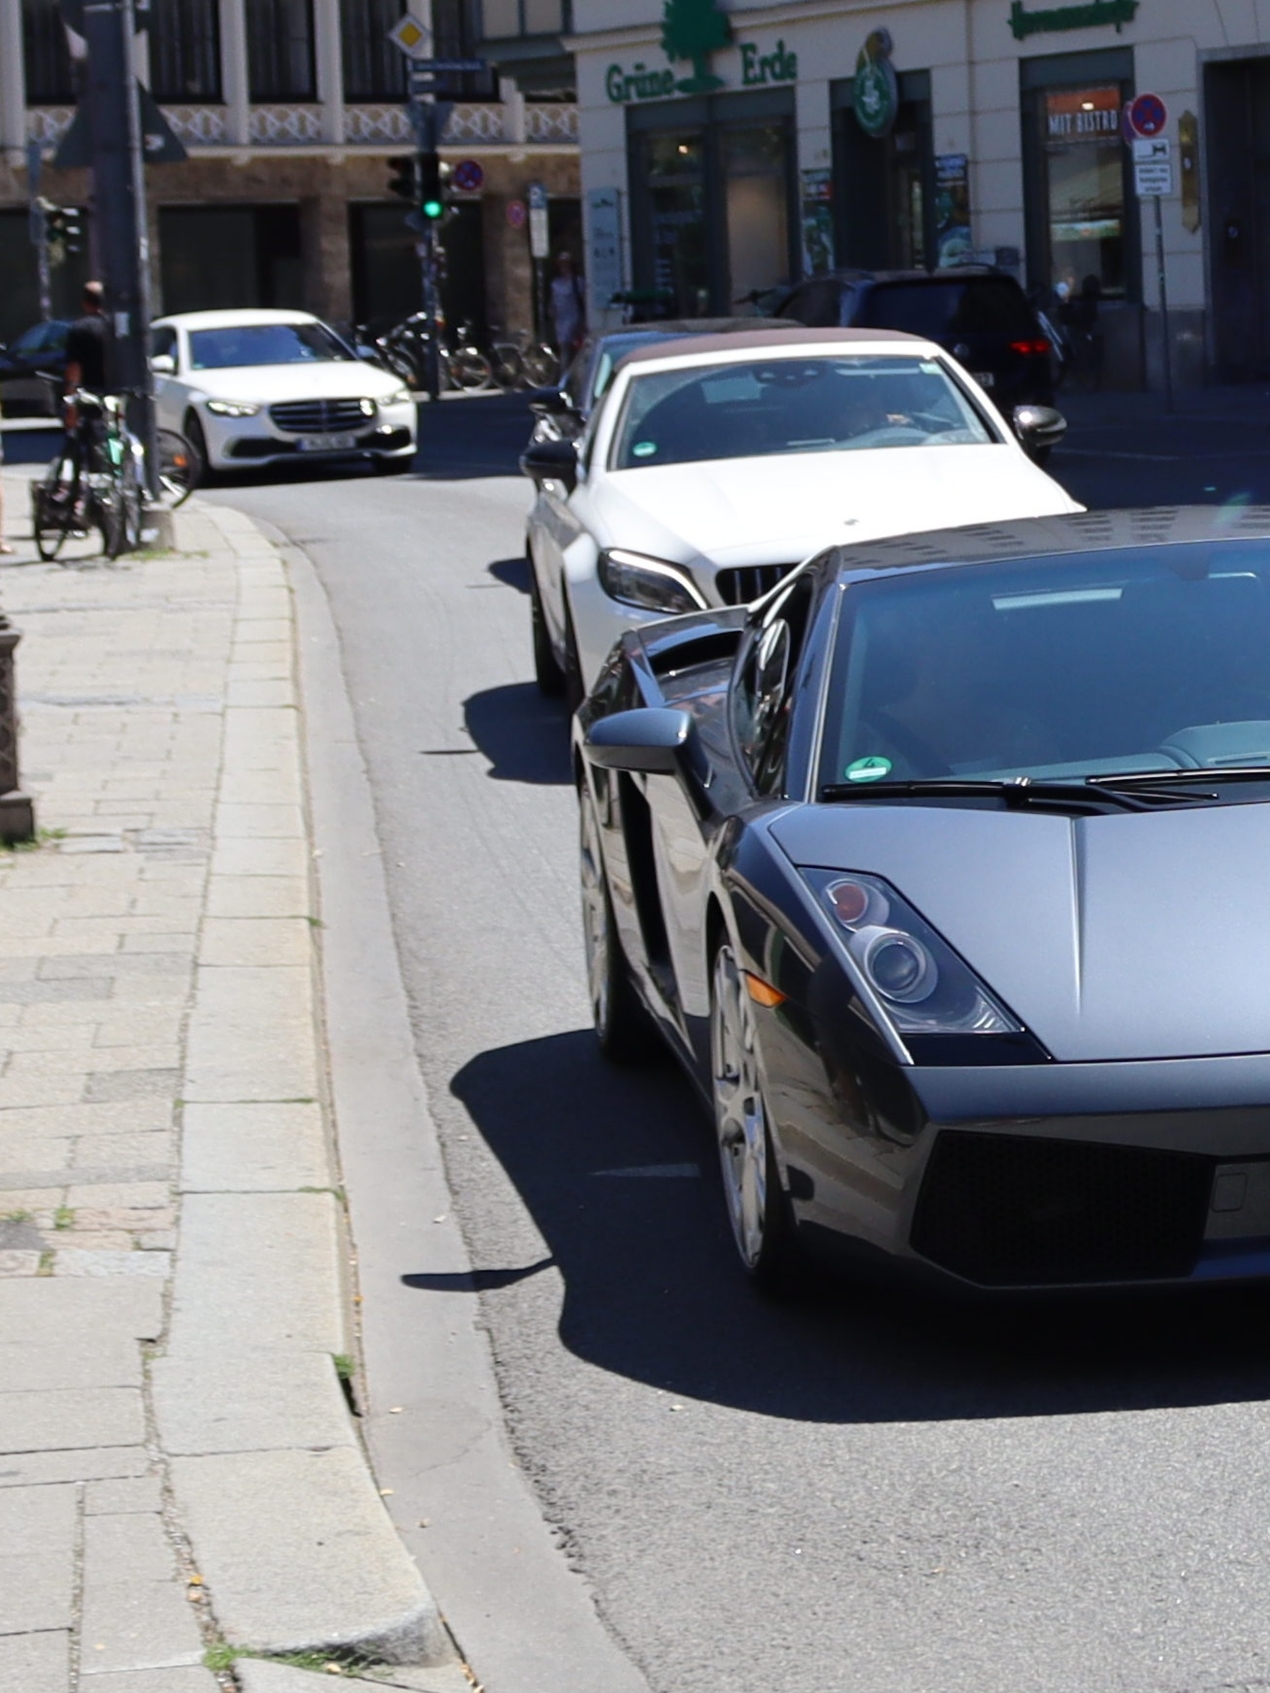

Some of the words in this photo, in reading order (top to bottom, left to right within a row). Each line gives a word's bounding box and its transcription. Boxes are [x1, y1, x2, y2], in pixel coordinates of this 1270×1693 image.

[606, 64, 674, 102] Grüne
[740, 40, 797, 85] Erde
[1049, 113, 1071, 136] MIT
[1076, 110, 1119, 133] BISTRO
